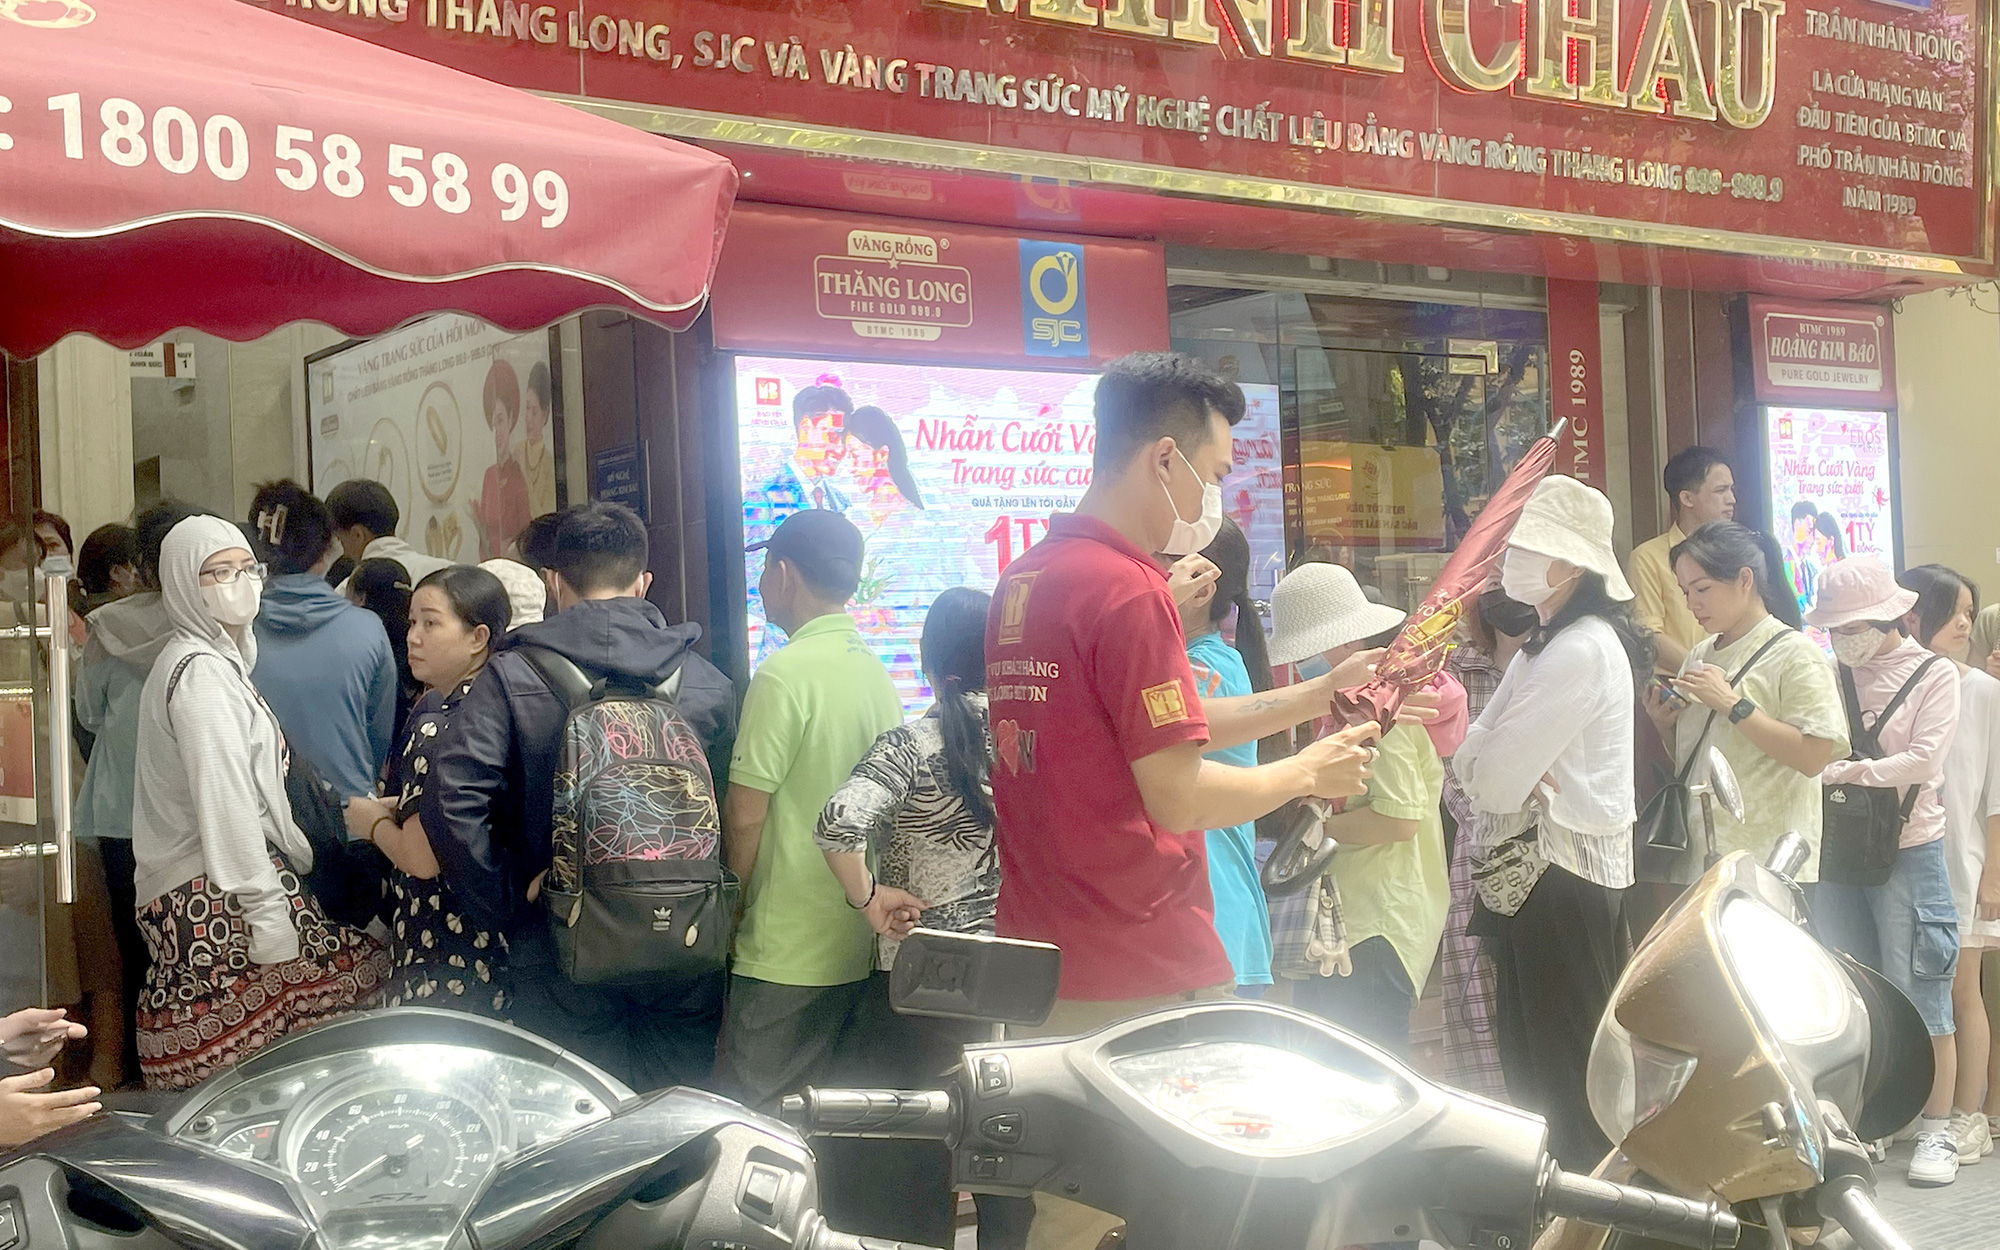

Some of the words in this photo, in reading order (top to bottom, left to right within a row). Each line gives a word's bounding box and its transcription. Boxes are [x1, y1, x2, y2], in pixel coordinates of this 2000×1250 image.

[1805, 6, 1857, 42] TRẦN
[1857, 21, 1911, 54] NHÂN
[1915, 29, 1965, 63] TÔNG
[568, 10, 684, 69] LONG,
[693, 31, 756, 73] SJC
[764, 36, 810, 80] VÀ
[820, 44, 909, 93] VÀNG
[914, 62, 1017, 108] TRANG
[1022, 73, 1081, 116] SỨC
[1086, 84, 1130, 123] MỸ
[1136, 95, 1211, 141] NGHỆ
[1216, 101, 1284, 142] CHẤT
[1289, 111, 1343, 154] LIỆU
[1347, 112, 1414, 158] BẰNG
[1418, 128, 1481, 166] VÀNG
[1485, 133, 1547, 174] RỒNG
[1551, 146, 1624, 184] THĂNG
[1627, 159, 1682, 191] LONG
[1812, 68, 1834, 93] LÀ
[1835, 69, 1866, 99] CỬA
[1867, 77, 1912, 108] HÀNG
[1797, 101, 1831, 130] ĐẦU
[1835, 110, 1868, 136] TIÊN
[1870, 114, 1901, 142] CỦA
[1904, 122, 1946, 150] BTMC
[47, 92, 250, 181] 1800
[275, 125, 365, 198] 58
[387, 143, 472, 214] 58
[491, 162, 569, 229] 99
[1798, 142, 1832, 169] PHỐ
[1835, 146, 1876, 175] TRẦN
[1877, 155, 1920, 181] NHÂN
[1923, 160, 1964, 187] TÔNG
[1843, 184, 1881, 211] NĂM
[1883, 194, 1917, 216] 1989
[853, 235, 892, 253] VÀNG
[894, 236, 934, 257] RỒNG
[819, 270, 900, 299] THĂNG
[906, 279, 967, 305] LONG
[850, 300, 875, 314] FINE
[880, 303, 906, 316] GOLD
[866, 324, 895, 336] BTMC
[1032, 317, 1082, 347] SJC
[1800, 322, 1824, 336] BTMC
[1826, 325, 1846, 337] 1989
[381, 334, 408, 369] TRANG
[1771, 333, 1818, 358] HOÀNG
[1820, 340, 1846, 362] KIM
[1848, 337, 1875, 363] BẢO
[1569, 349, 1587, 406] 1989
[1781, 368, 1804, 380] PURE
[1806, 370, 1831, 382] GOLD
[1833, 373, 1869, 384] JEWELRY
[915, 414, 994, 452] Nhẫn
[1002, 421, 1063, 453] Cưới
[1850, 429, 1881, 445] EROS
[951, 458, 1015, 491] Trang
[1022, 459, 1059, 486] sức
[1783, 456, 1815, 476] Nhẫn
[1818, 459, 1844, 477] Cưới
[1846, 460, 1875, 481] Vàng
[1797, 479, 1825, 497] Trang
[1826, 481, 1843, 494] sức
[1844, 480, 1864, 494] cưới
[995, 497, 1019, 510] TẶNG
[1021, 496, 1037, 508] LÊN
[1056, 495, 1076, 508] GẦN
[1022, 656, 1059, 679] HÀNG
[348, 1104, 363, 1116] 60
[315, 1129, 331, 1141] 40
[465, 1123, 481, 1133] 120
[302, 1161, 319, 1173] 20
[472, 1152, 489, 1163] 140
